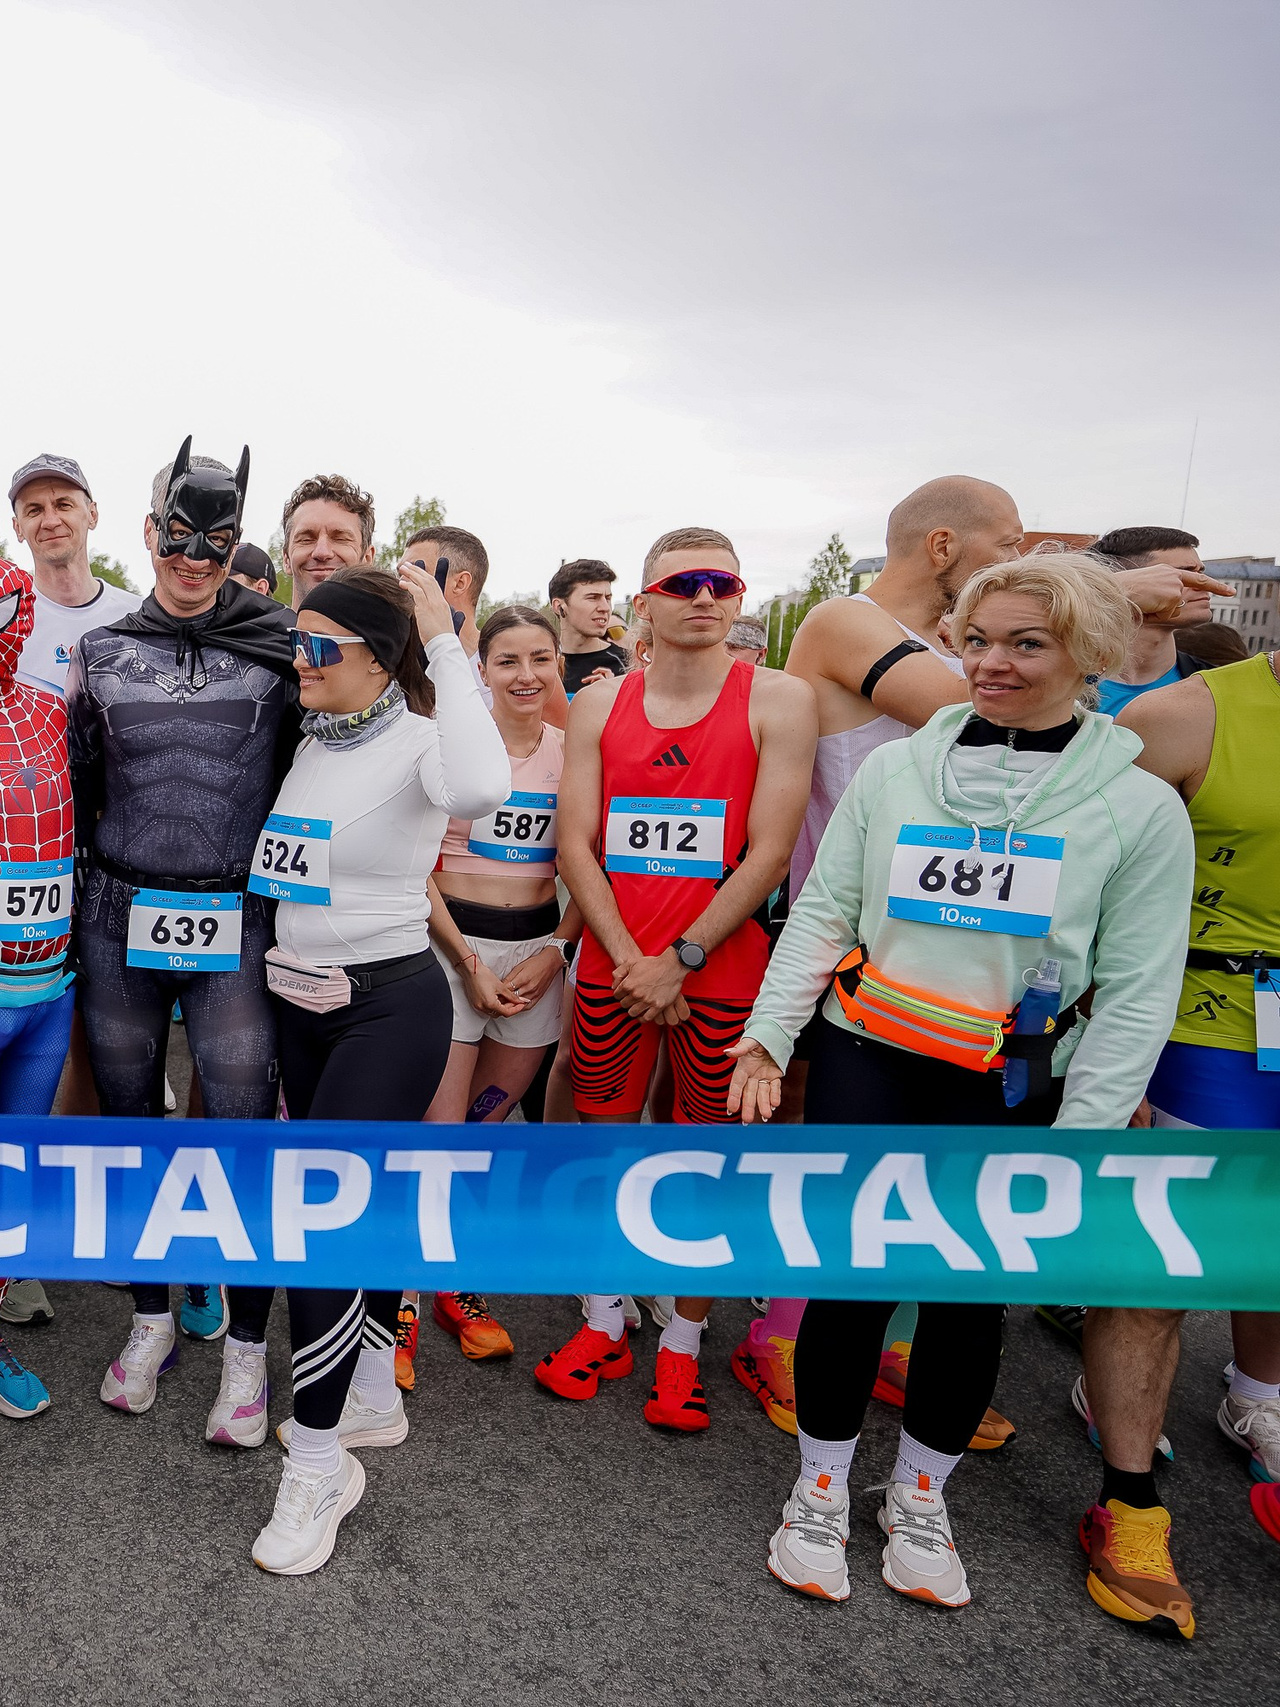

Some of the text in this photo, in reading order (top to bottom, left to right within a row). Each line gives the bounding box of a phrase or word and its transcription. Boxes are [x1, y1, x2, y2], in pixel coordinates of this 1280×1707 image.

[493, 810, 552, 842] 587
[628, 819, 698, 853] 812
[262, 837, 309, 877] 524
[918, 855, 1015, 902] 681
[6, 883, 61, 917] 570
[150, 914, 219, 947] 639
[278, 977, 319, 995] DEMIX
[615, 1150, 1218, 1277] СТАРТ
